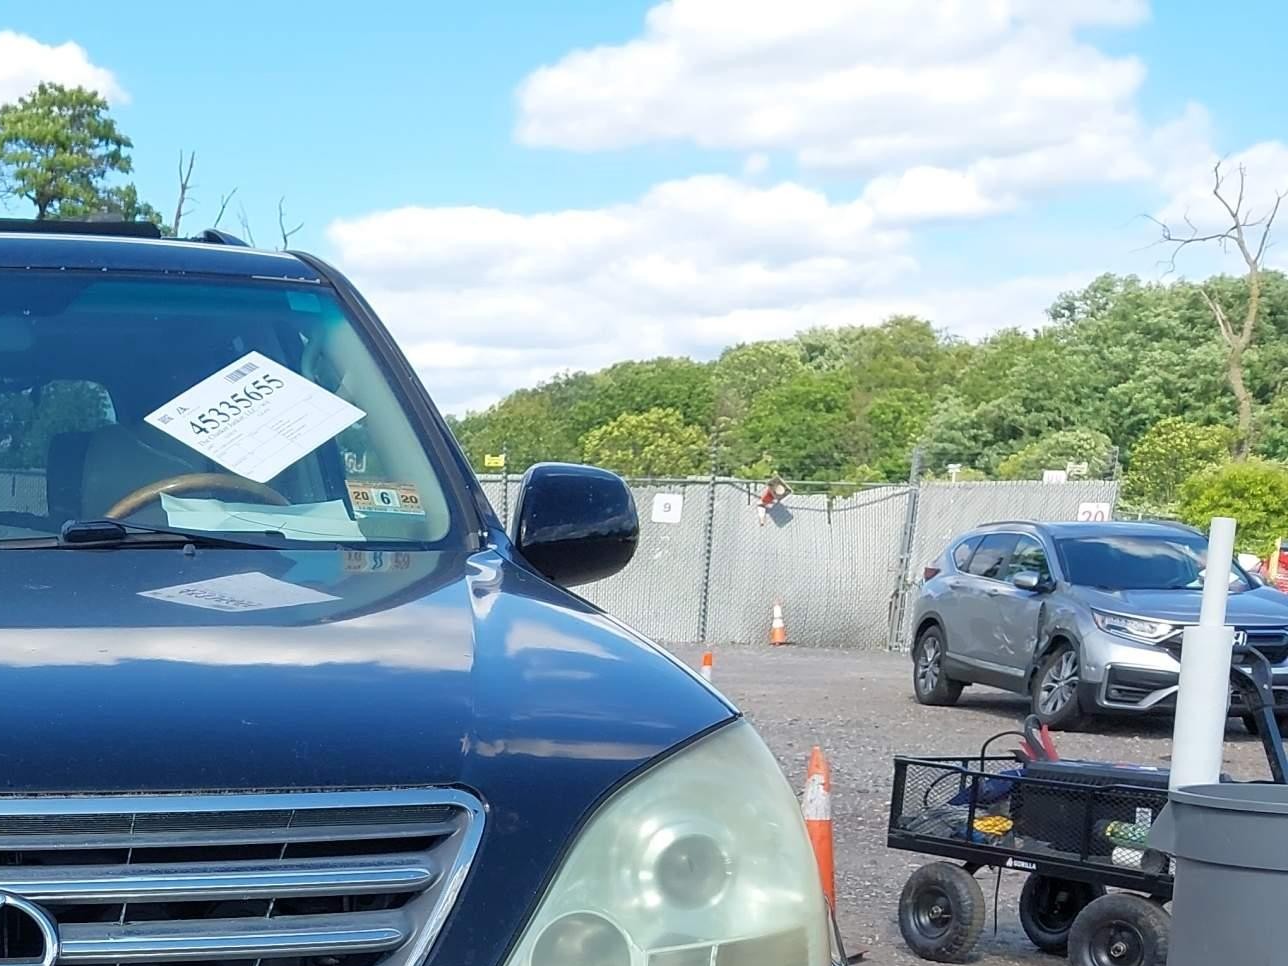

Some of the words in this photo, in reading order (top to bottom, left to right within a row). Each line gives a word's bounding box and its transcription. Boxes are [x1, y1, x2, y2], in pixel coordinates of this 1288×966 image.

[190, 374, 285, 434] 45335655
[353, 491, 370, 501] 20
[380, 491, 392, 505] 6
[401, 494, 418, 504] 20
[663, 502, 672, 513] 9
